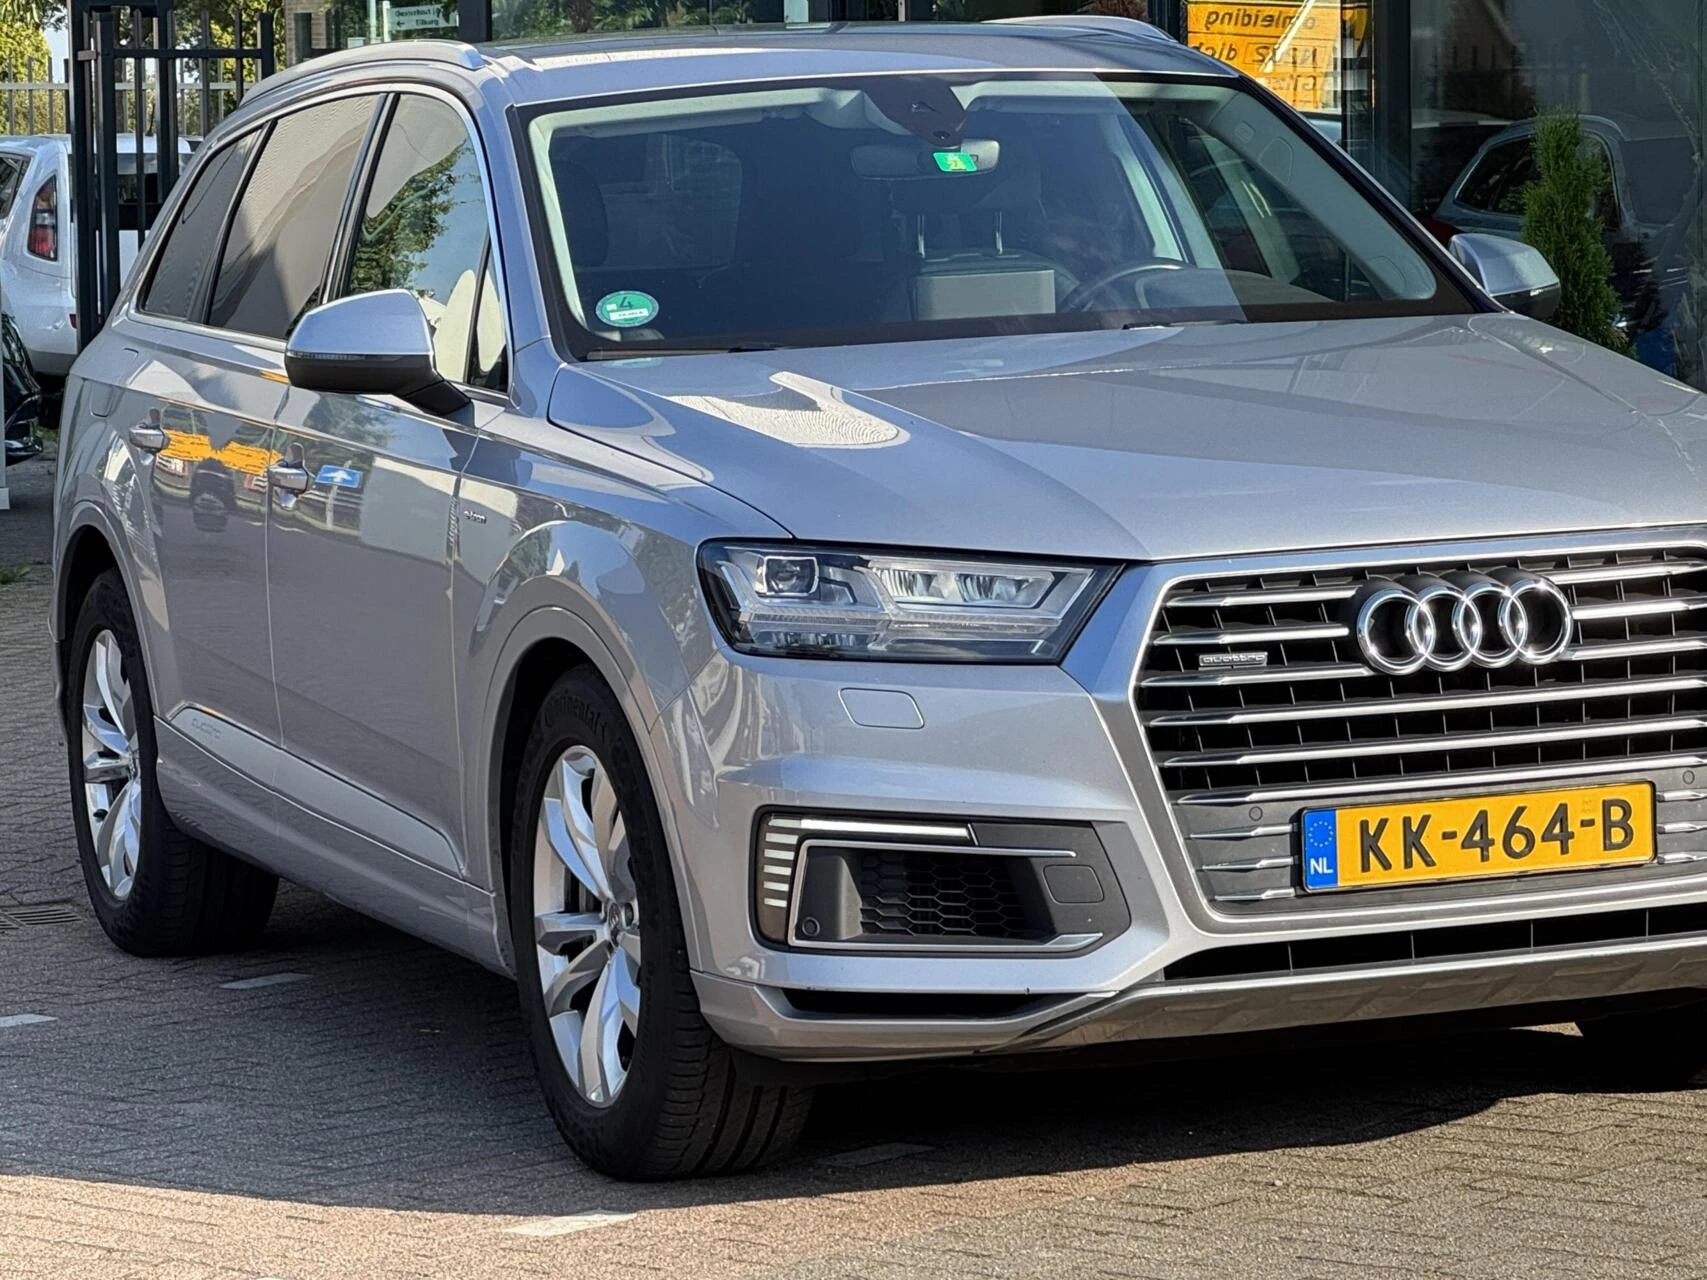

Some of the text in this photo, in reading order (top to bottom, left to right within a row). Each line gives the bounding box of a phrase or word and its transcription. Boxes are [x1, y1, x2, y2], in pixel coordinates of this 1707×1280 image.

[1202, 654, 1266, 664] quattro
[1359, 798, 1635, 874] KK-464-B
[1309, 857, 1334, 875] NL
